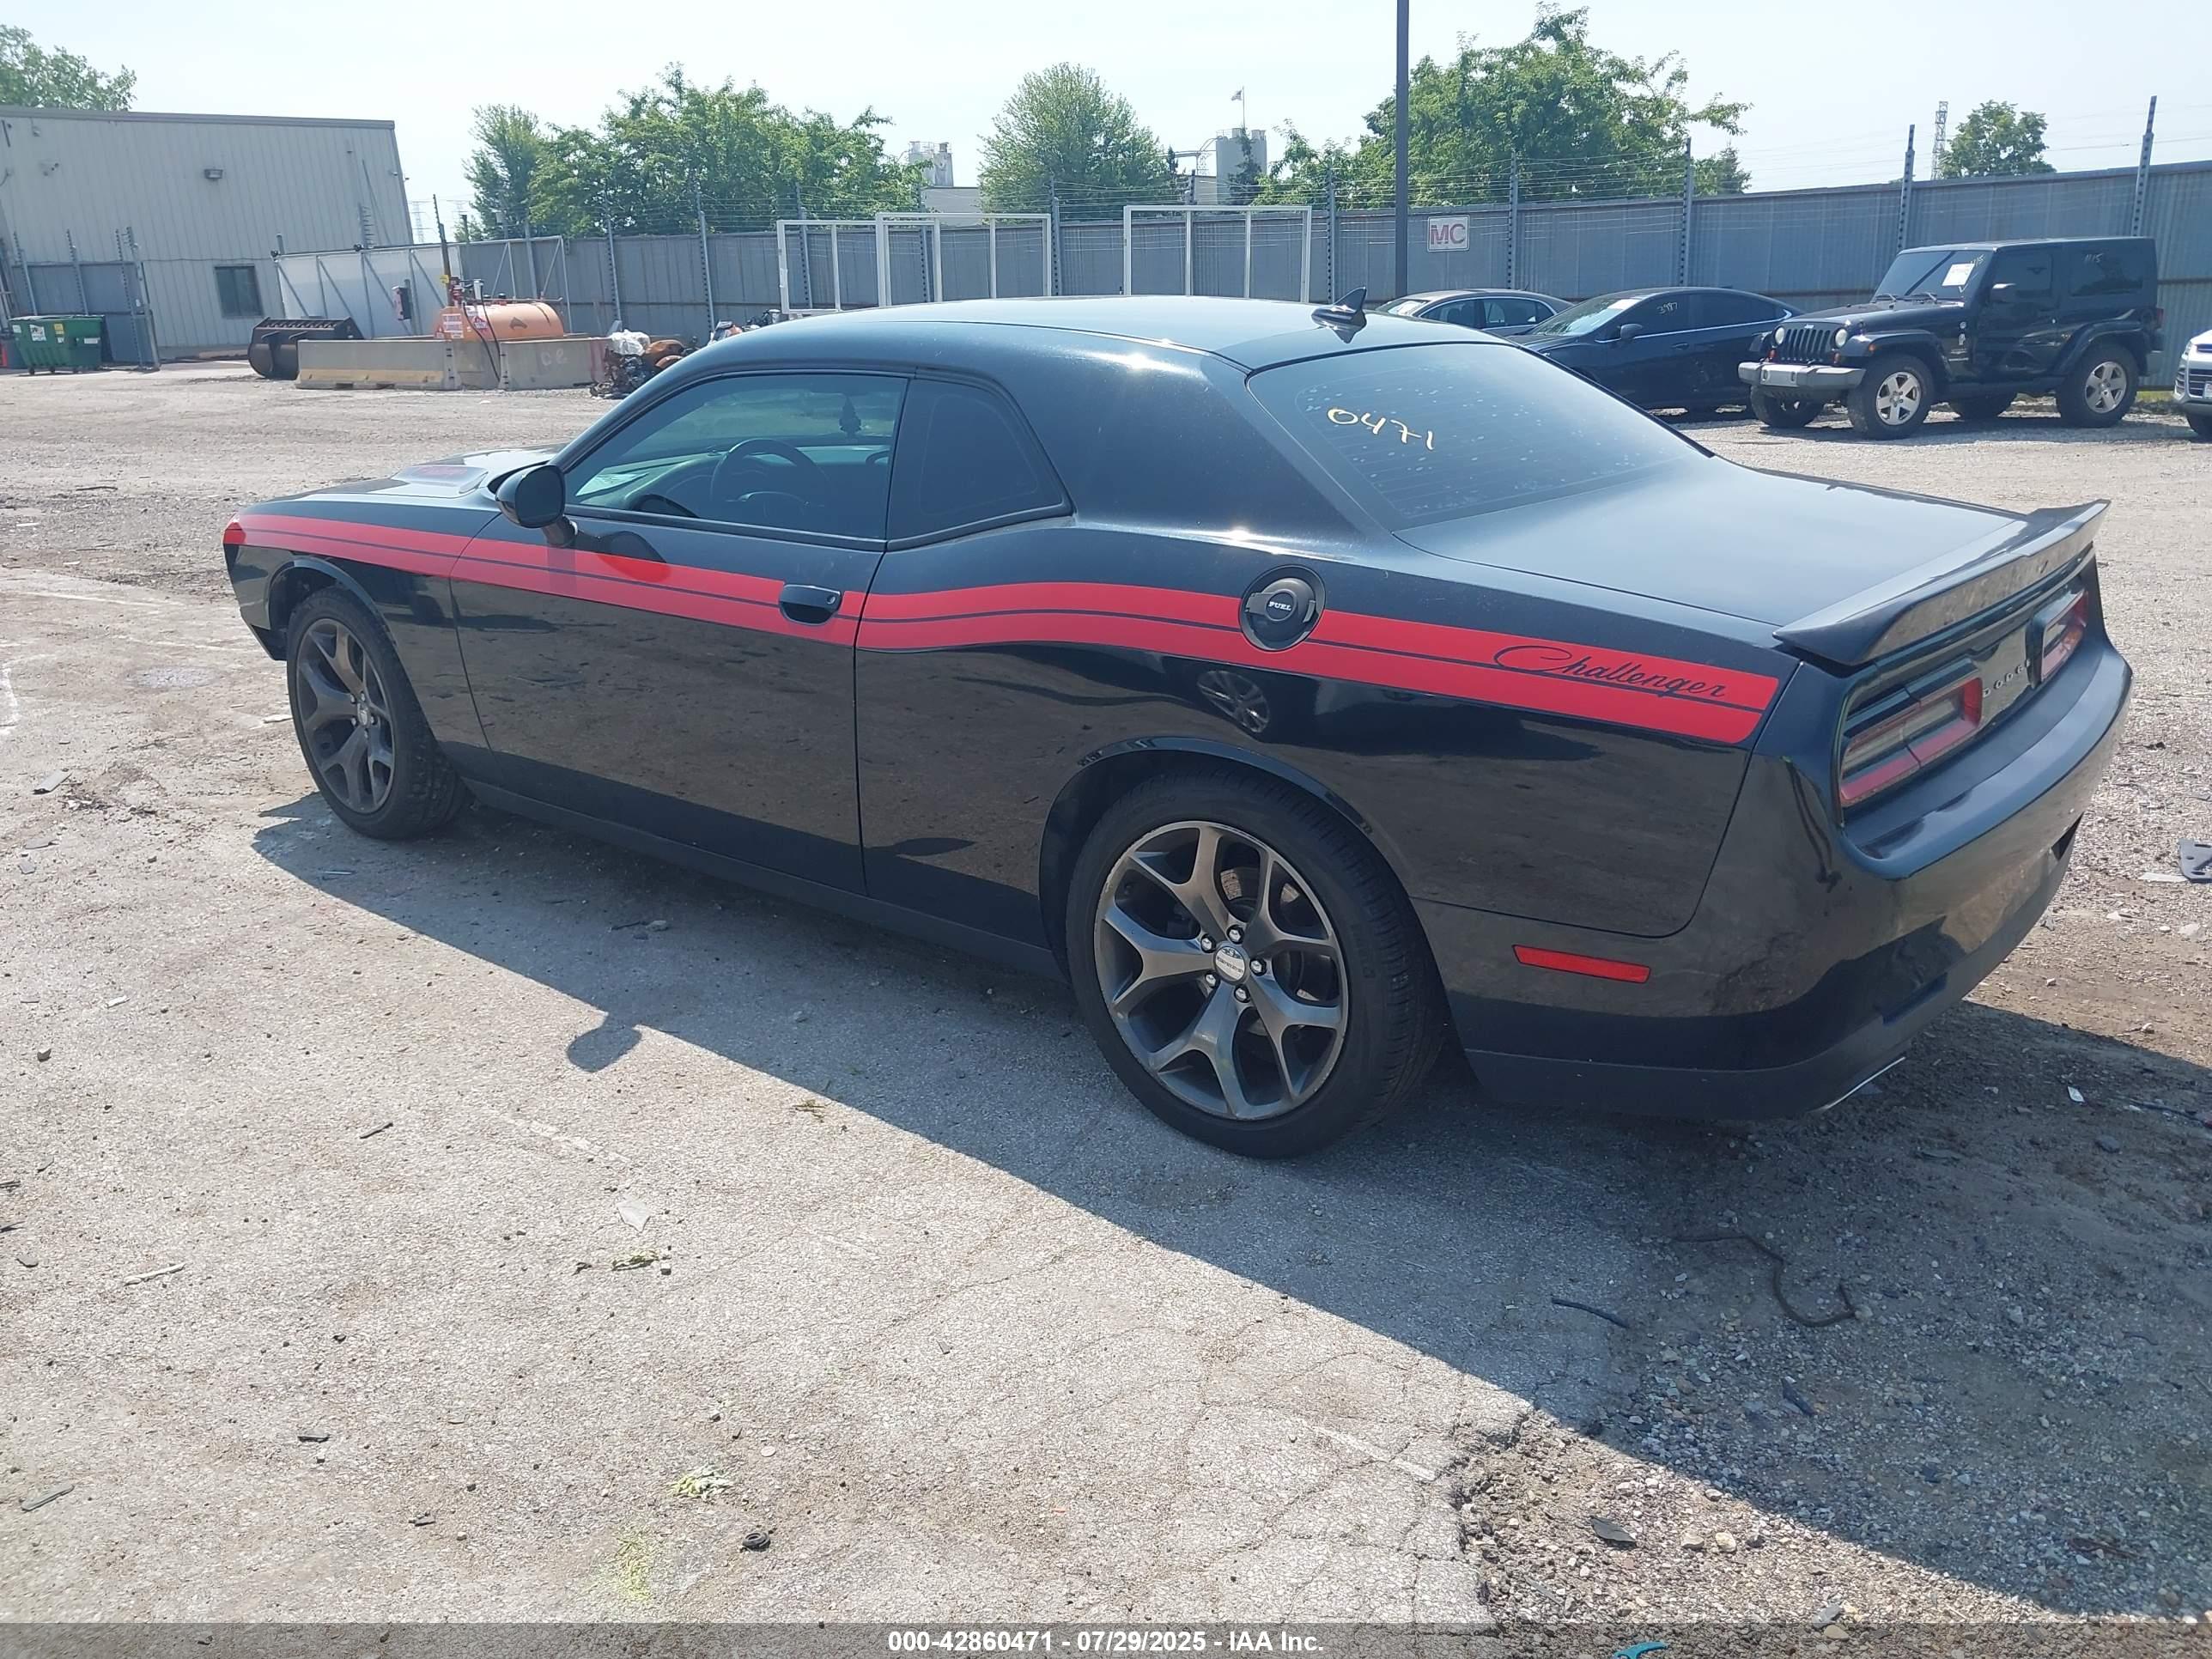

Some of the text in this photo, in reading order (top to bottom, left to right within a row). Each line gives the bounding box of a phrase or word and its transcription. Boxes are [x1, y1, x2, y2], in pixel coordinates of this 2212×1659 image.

[1431, 224, 1465, 244] MC
[1328, 409, 1433, 450] 0471
[1268, 601, 1291, 611] FUEL
[1493, 646, 1725, 697] Challenger
